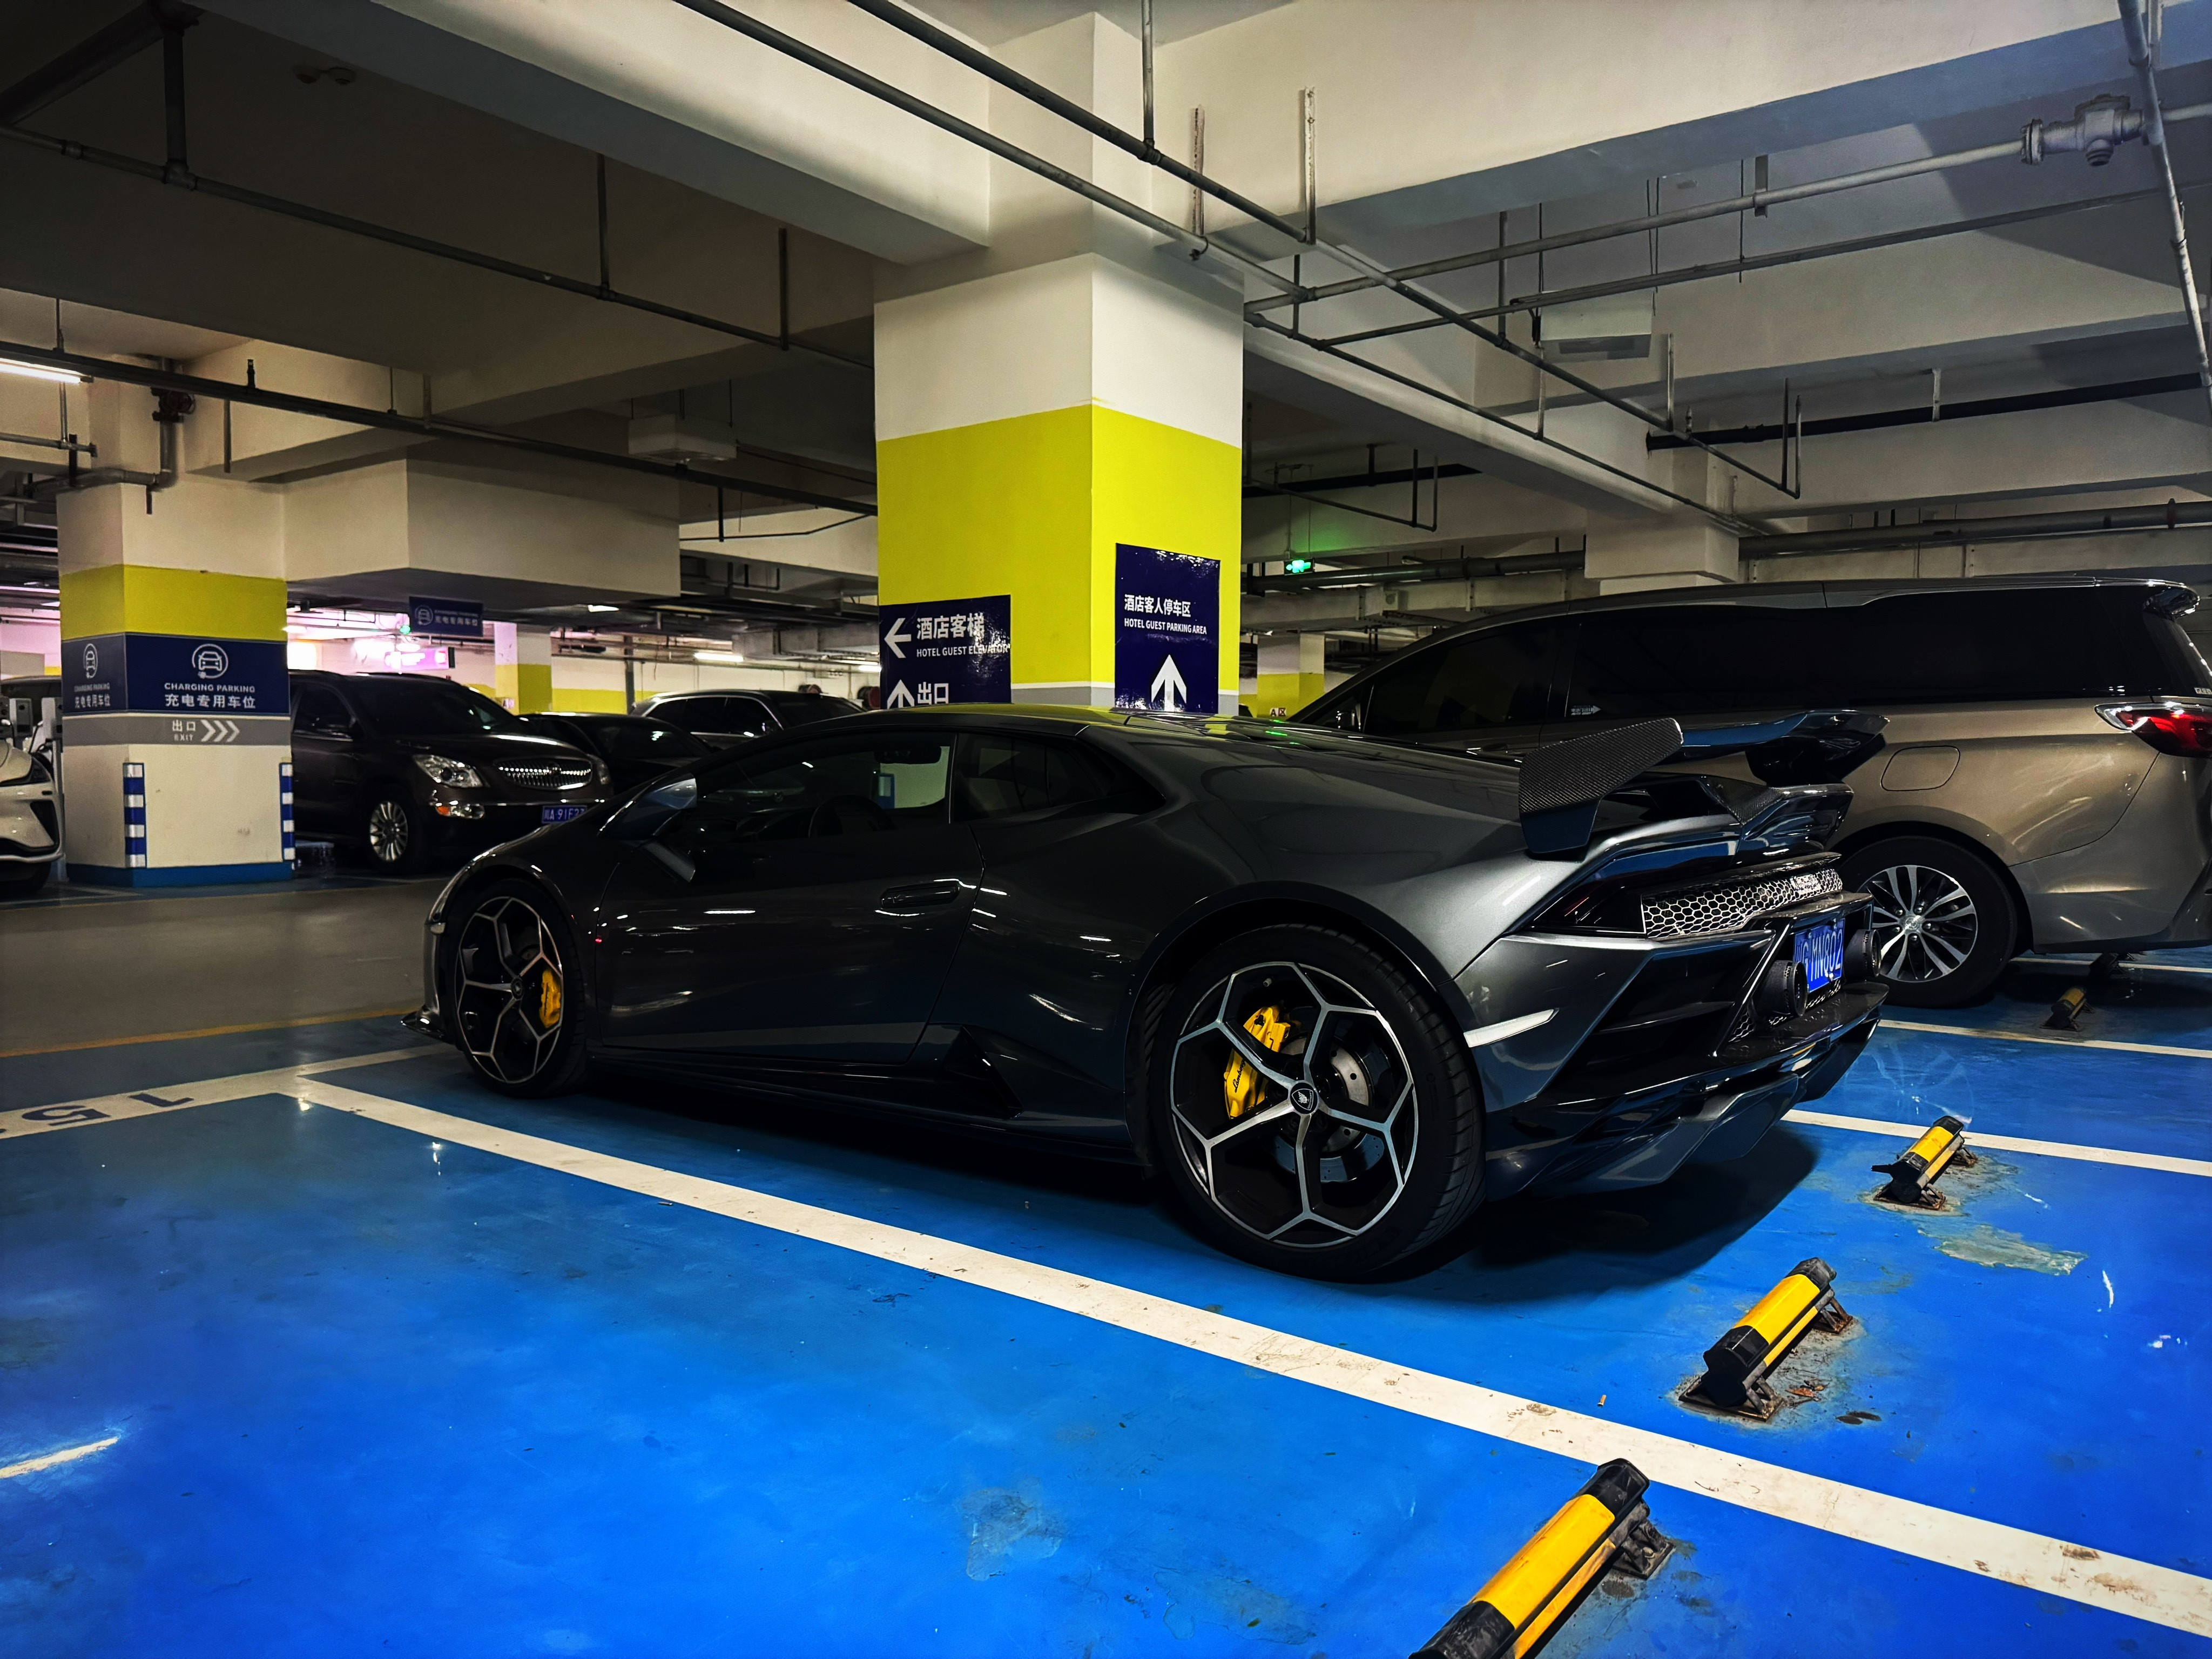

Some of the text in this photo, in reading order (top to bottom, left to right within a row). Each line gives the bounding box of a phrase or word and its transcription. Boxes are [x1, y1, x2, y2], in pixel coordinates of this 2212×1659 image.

[1124, 594, 1191, 617] 酒店客人停车区
[916, 612, 985, 640] 酒店客梯
[1124, 618, 1207, 635] HOTEL GUEST PARKING AREA
[916, 648, 941, 658] HOTEL
[942, 646, 967, 657] GUEST
[164, 683, 255, 693] CHARGING PARKING
[918, 682, 949, 705] 出口
[165, 693, 255, 709] 充电专用车位
[172, 719, 196, 732] 出口
